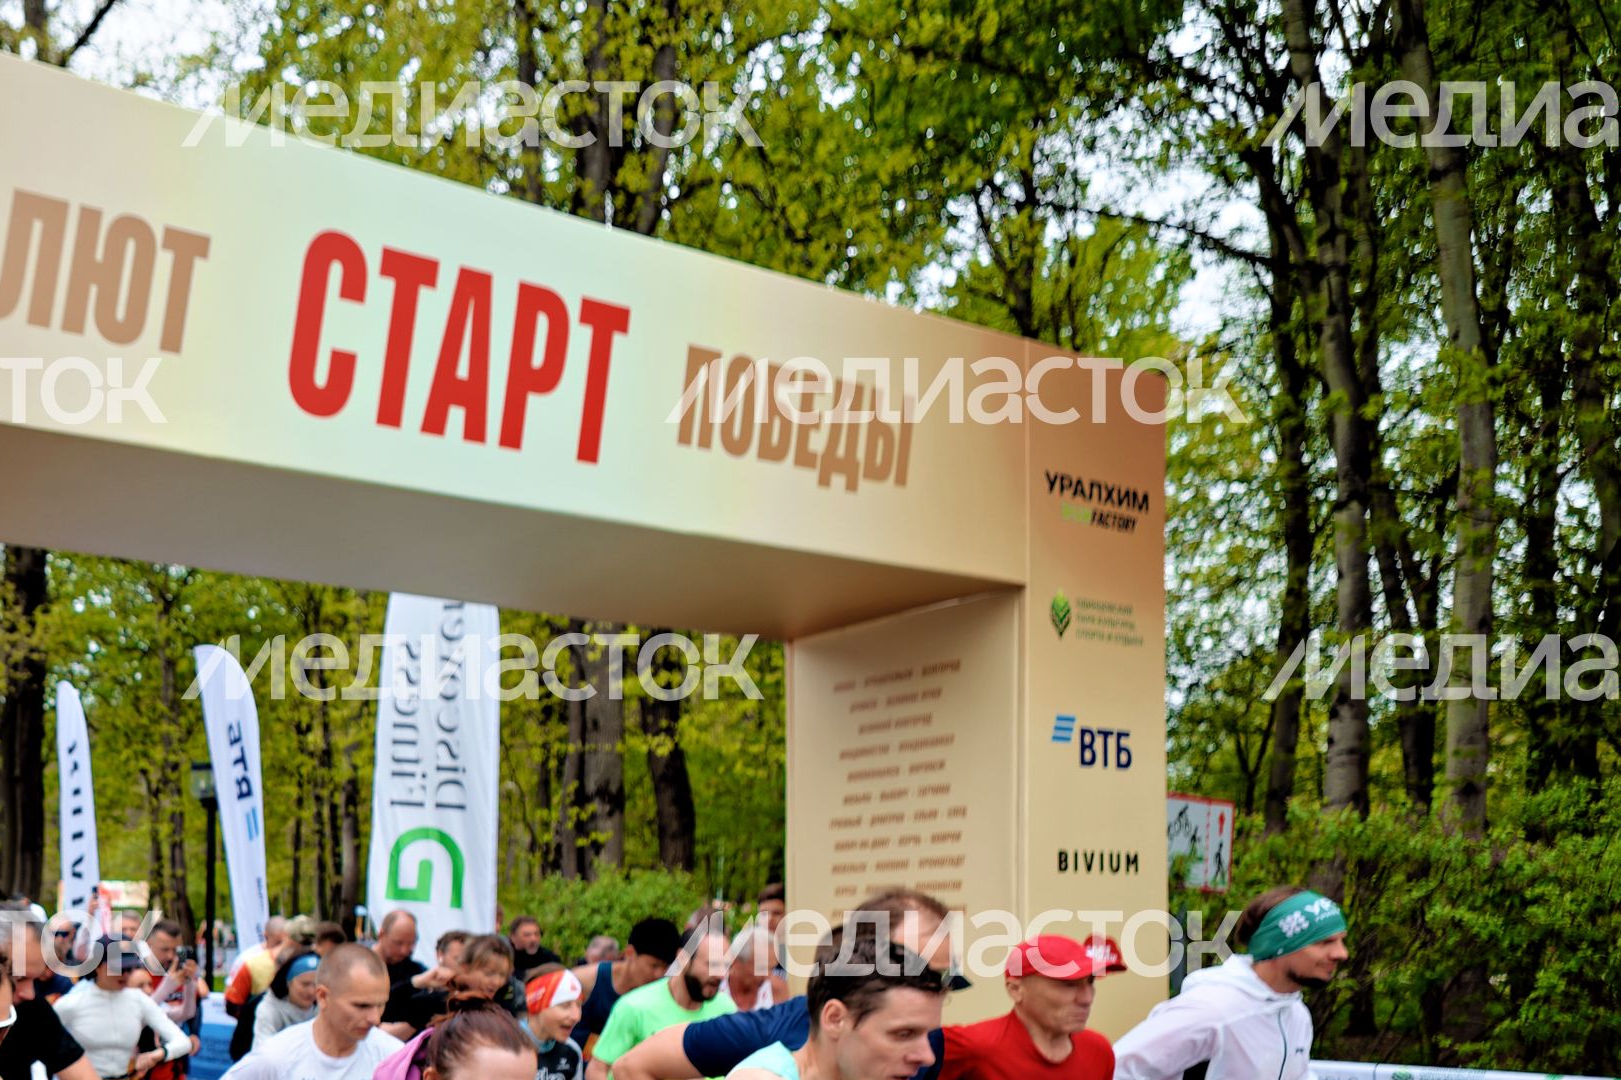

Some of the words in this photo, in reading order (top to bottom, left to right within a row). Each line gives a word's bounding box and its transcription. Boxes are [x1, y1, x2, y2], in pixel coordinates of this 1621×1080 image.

[288, 229, 631, 466] СТАРТ
[677, 342, 917, 493] ПОБЕДЫ
[1044, 470, 1151, 515] УРАЛХИМ
[1079, 727, 1133, 770] ВТБ
[1058, 849, 1140, 876] BIVIUM
